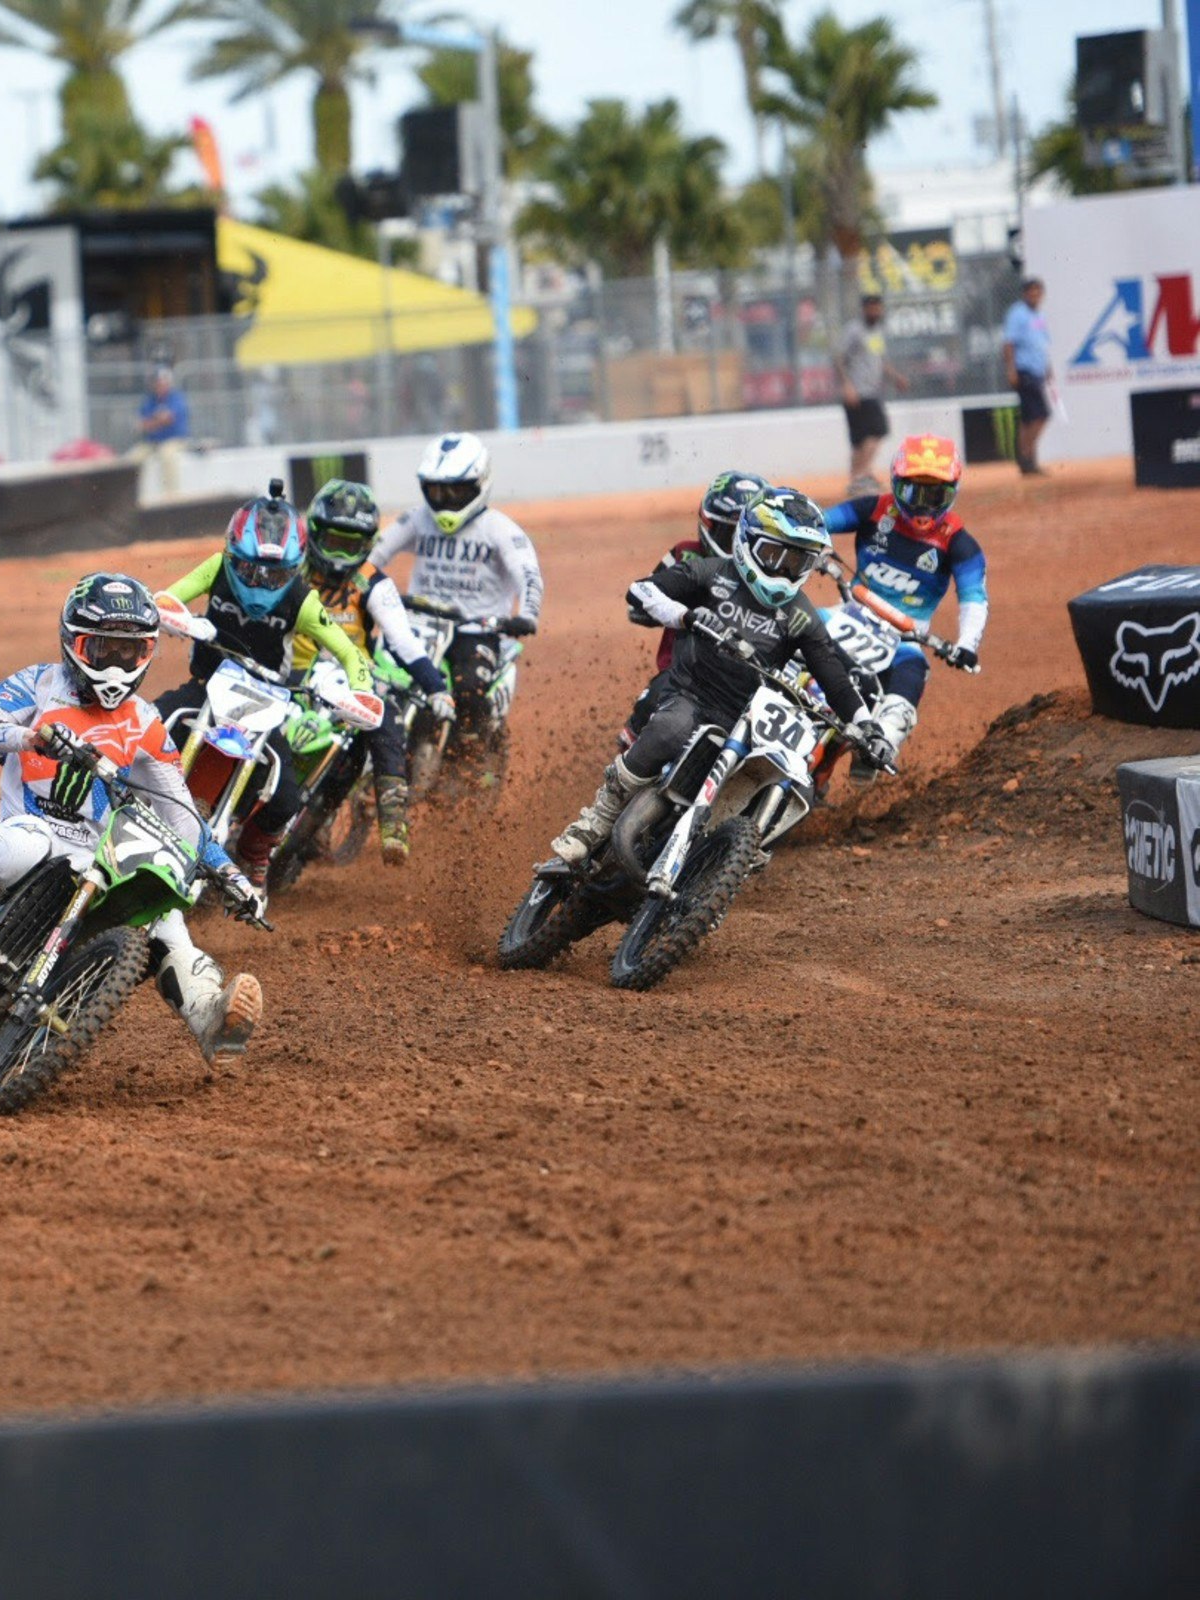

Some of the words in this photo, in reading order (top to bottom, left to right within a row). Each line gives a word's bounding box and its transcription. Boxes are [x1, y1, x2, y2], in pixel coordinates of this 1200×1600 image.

[864, 561, 920, 594] KTM
[226, 683, 275, 721] 7
[755, 702, 805, 752] 34
